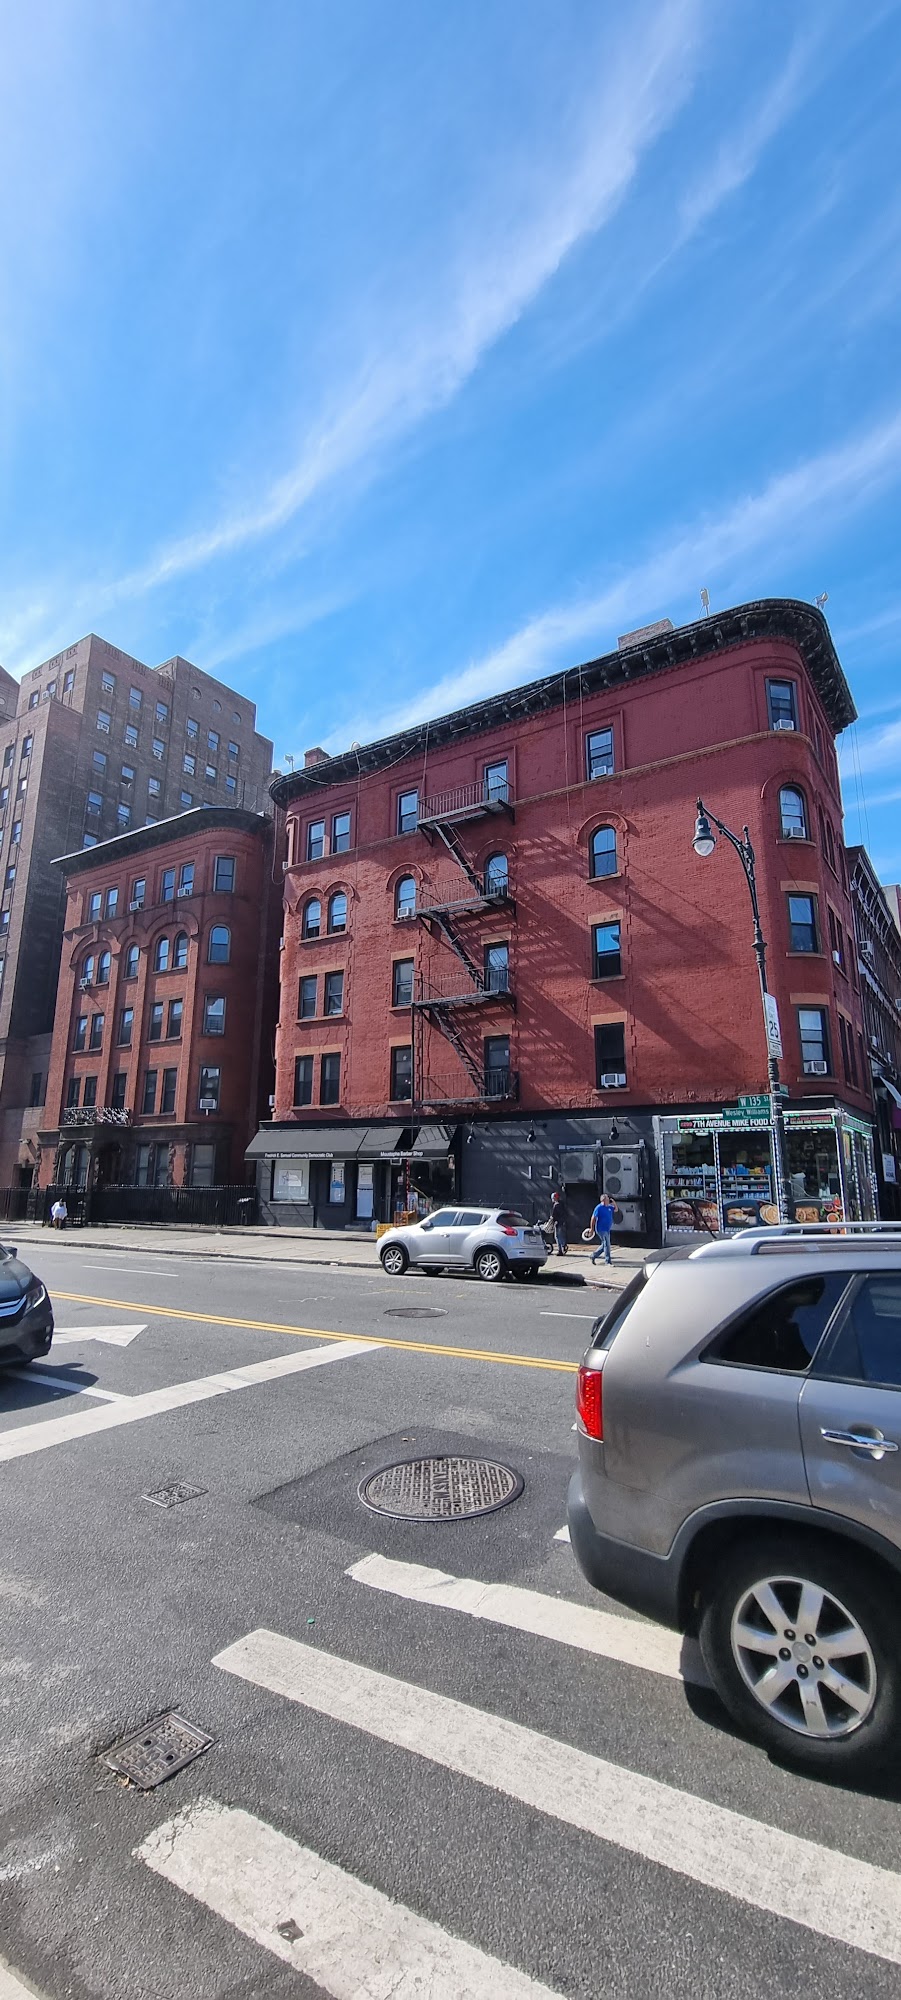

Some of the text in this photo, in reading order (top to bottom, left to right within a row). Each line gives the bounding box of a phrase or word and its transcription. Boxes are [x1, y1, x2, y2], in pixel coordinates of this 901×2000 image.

[769, 1020, 779, 1038] 25
[740, 1098, 747, 1107] W
[749, 1097, 762, 1106] 135
[692, 1120, 706, 1128] 7TH
[706, 1119, 731, 1127] AVENUE
[732, 1118, 749, 1126] MIKE
[750, 1118, 769, 1126] FOOD
